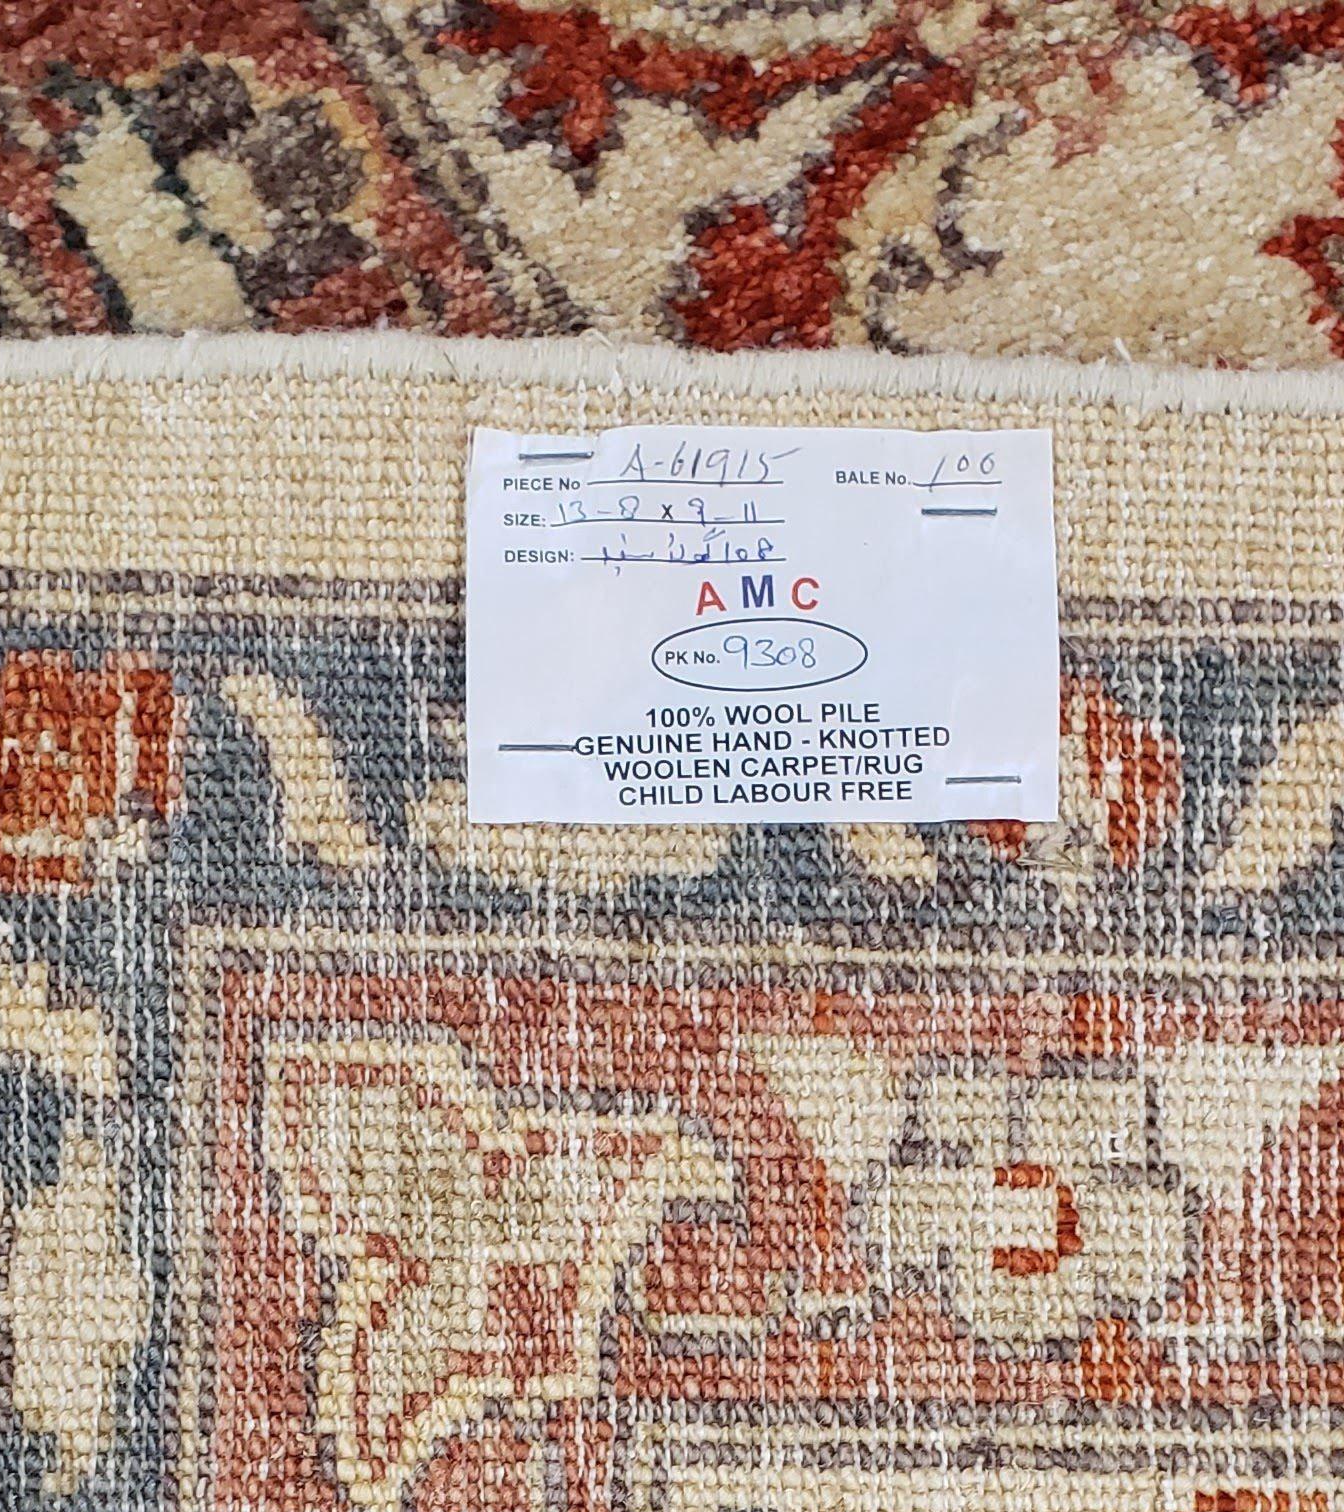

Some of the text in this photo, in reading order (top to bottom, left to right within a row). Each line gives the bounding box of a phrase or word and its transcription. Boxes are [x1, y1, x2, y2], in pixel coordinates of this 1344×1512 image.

[502, 478, 554, 491] PIECE
[558, 478, 581, 490] No
[835, 470, 880, 485] BALE
[885, 471, 912, 486] No.
[503, 513, 547, 527] SIZE:
[504, 549, 575, 564] DESIGN:
[664, 635, 817, 670] PK No. 9308
[645, 703, 881, 727] 100% WOOL PILE
[575, 733, 704, 756] GENUINE
[712, 730, 793, 753] HAND
[819, 726, 951, 750] KNOTTED
[604, 753, 924, 782] WOOLEN CARPET/RUG
[618, 780, 913, 806] CHILD LABOUR FREE
